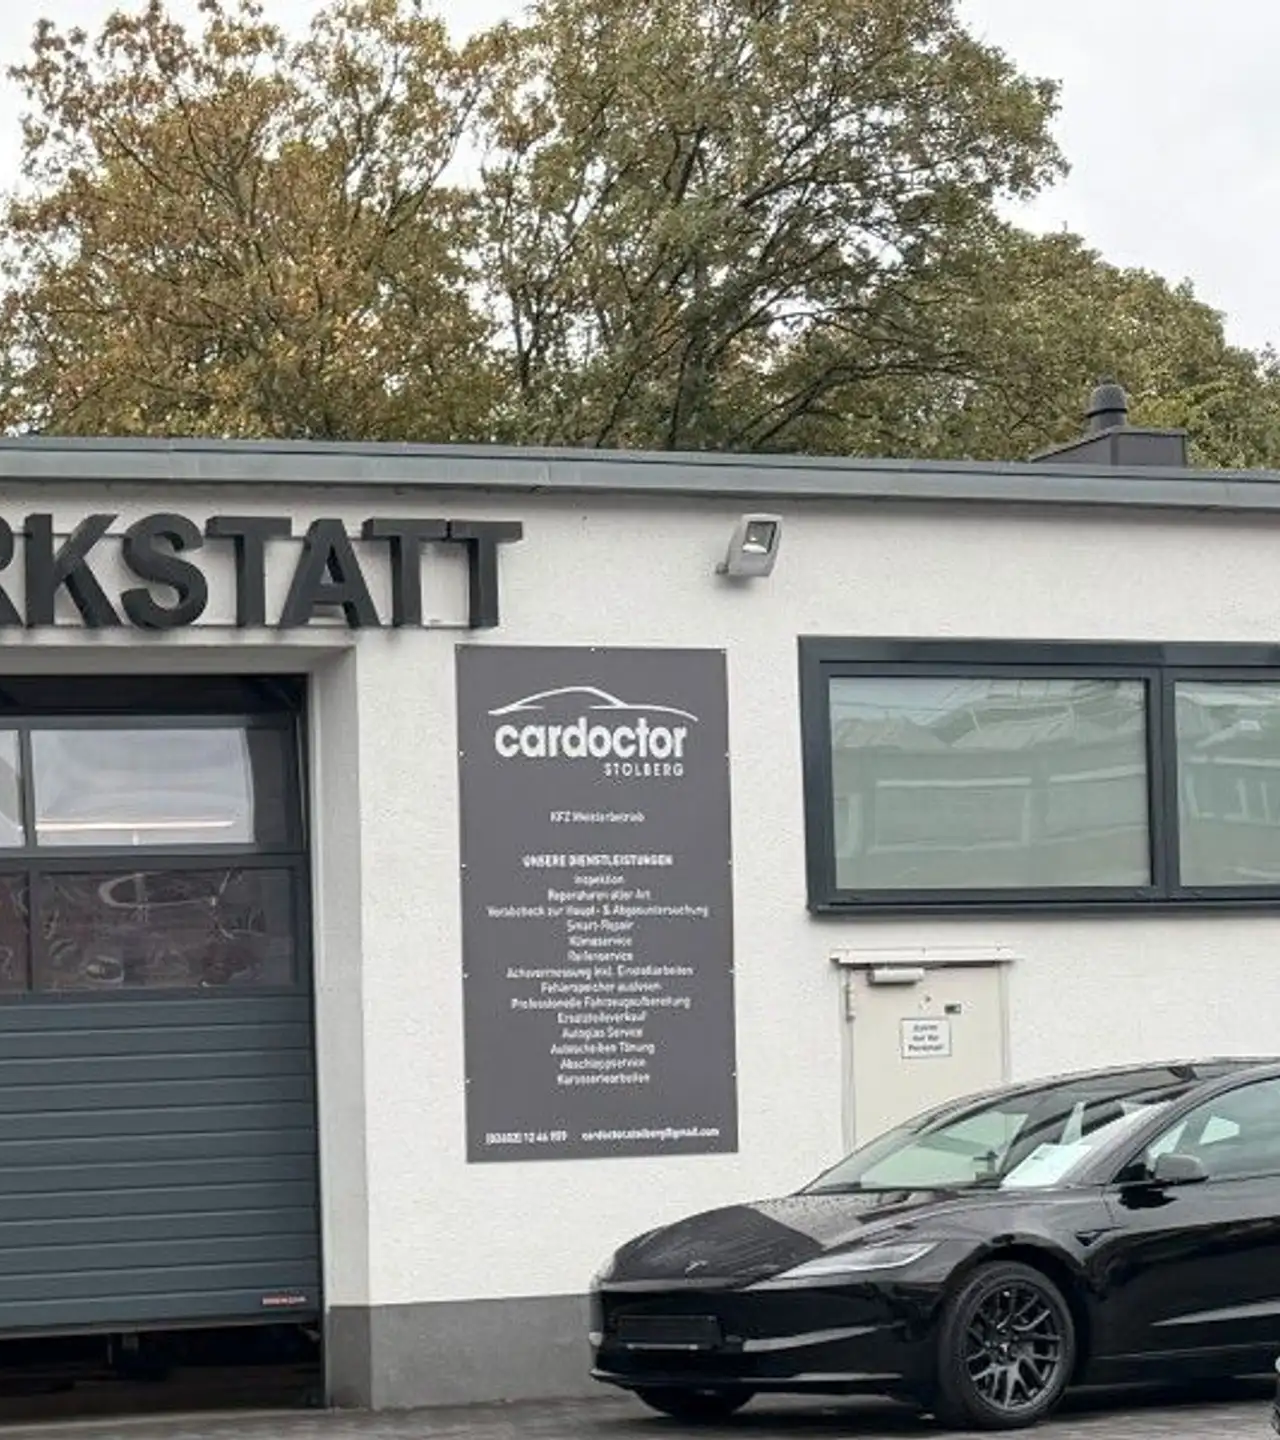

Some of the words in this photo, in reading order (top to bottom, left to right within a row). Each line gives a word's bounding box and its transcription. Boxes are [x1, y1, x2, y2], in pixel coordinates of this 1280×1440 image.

[494, 717, 687, 759] cardoctor
[603, 763, 684, 777] STOLBERG
[550, 811, 571, 823] KFZ
[522, 855, 566, 868] UNSERE
[568, 855, 673, 868] DIENSTLEISTUNGEN
[574, 874, 624, 886] Inspektion
[607, 1026, 643, 1038] Service
